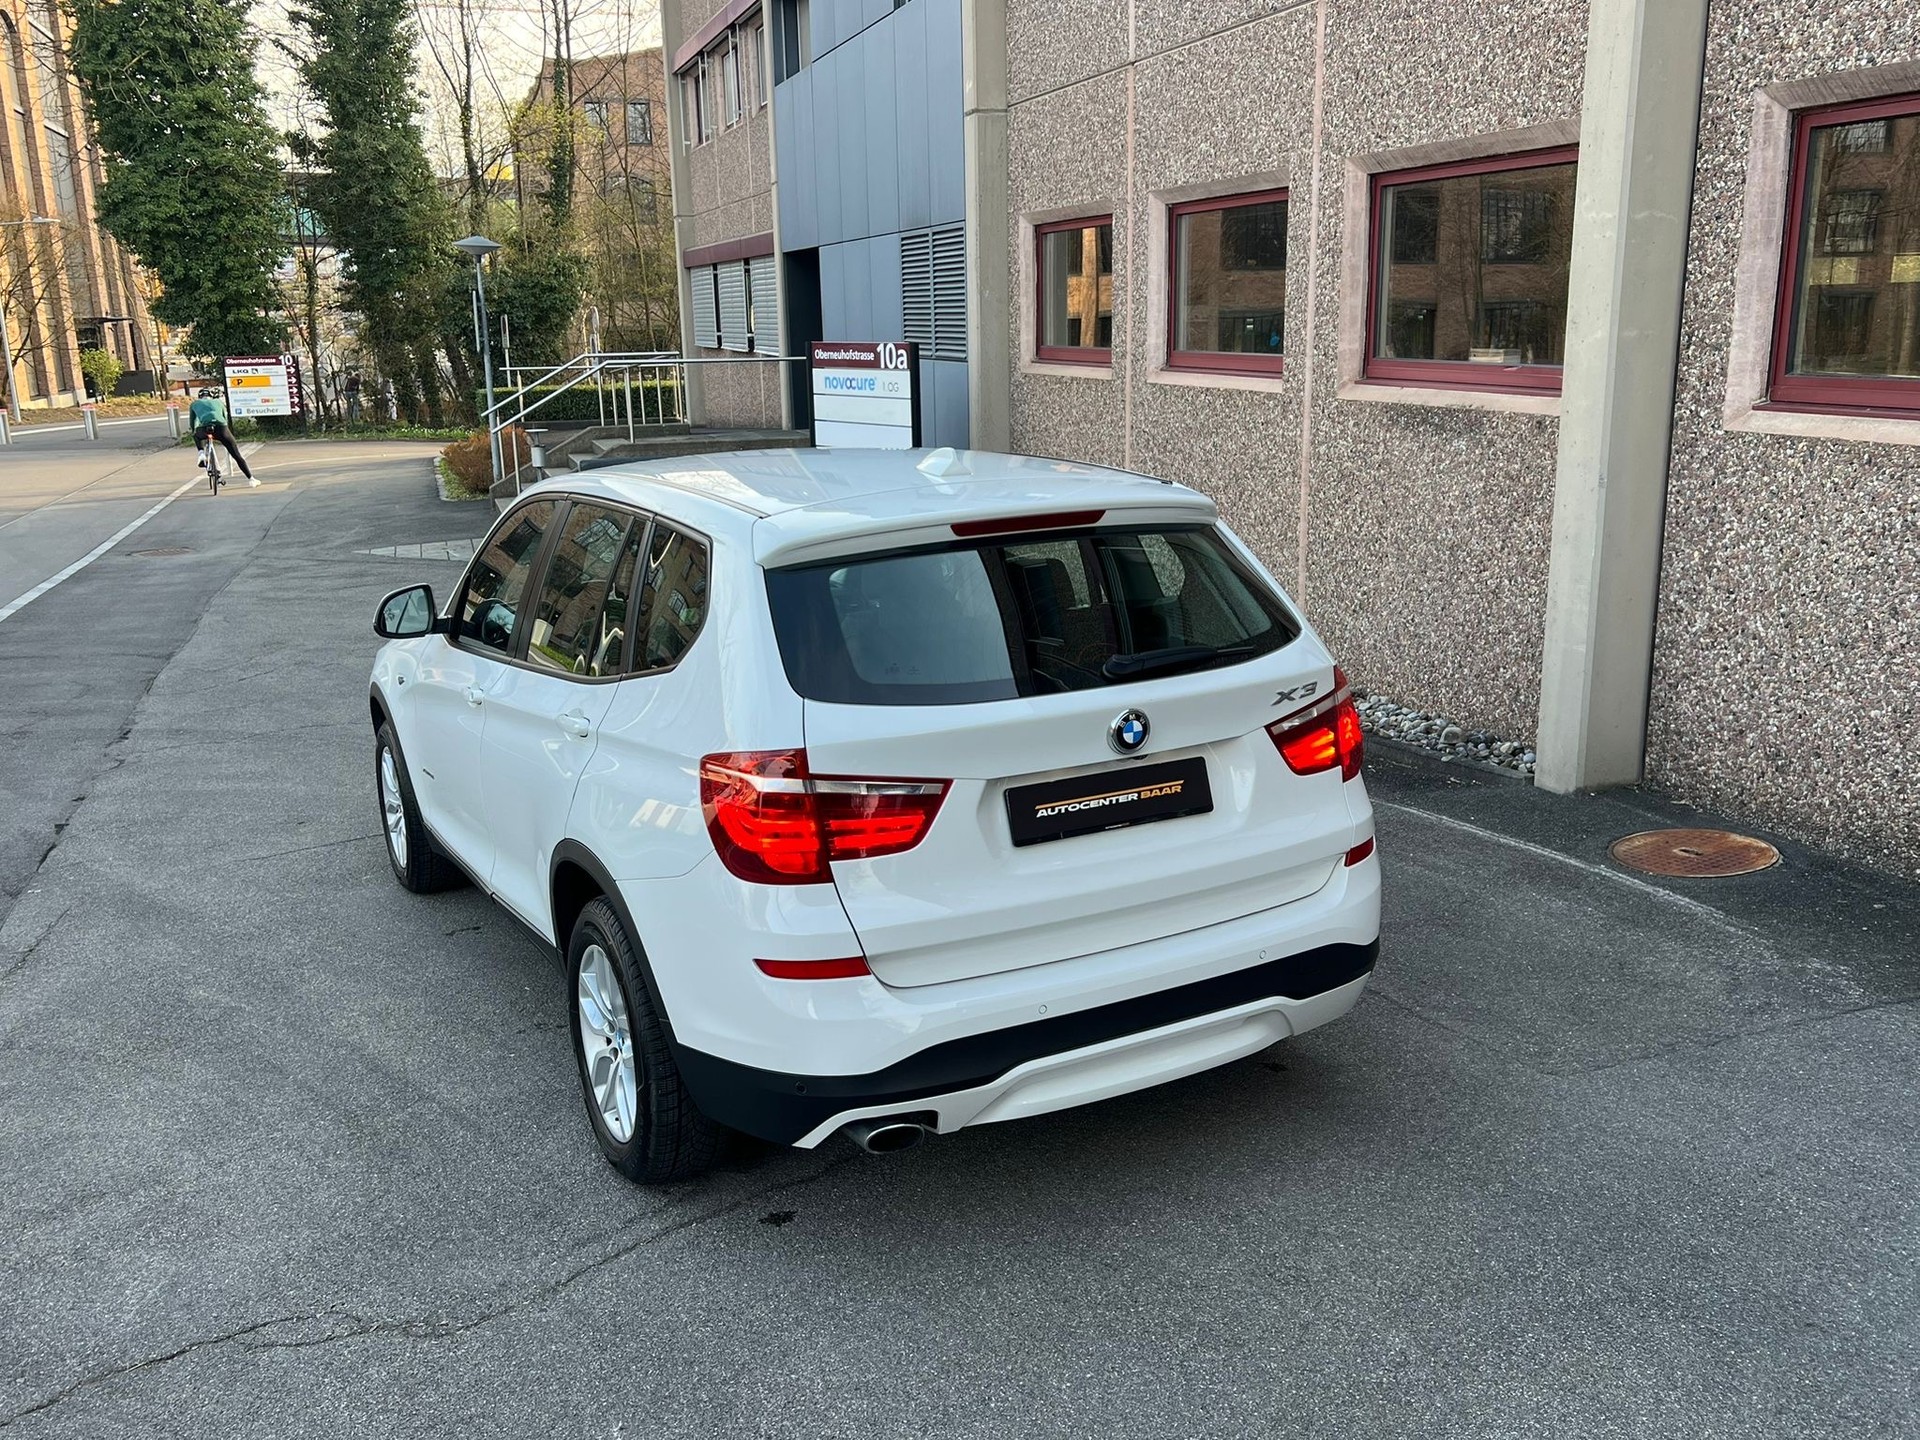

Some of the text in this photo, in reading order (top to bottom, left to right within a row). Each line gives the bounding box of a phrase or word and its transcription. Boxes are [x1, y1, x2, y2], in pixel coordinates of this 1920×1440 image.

[815, 343, 908, 369] Oberneuhofstrasse 10a
[825, 375, 876, 391] novocure
[1271, 681, 1318, 706] X3
[1036, 784, 1183, 818] AUTOCENTER BAAR
